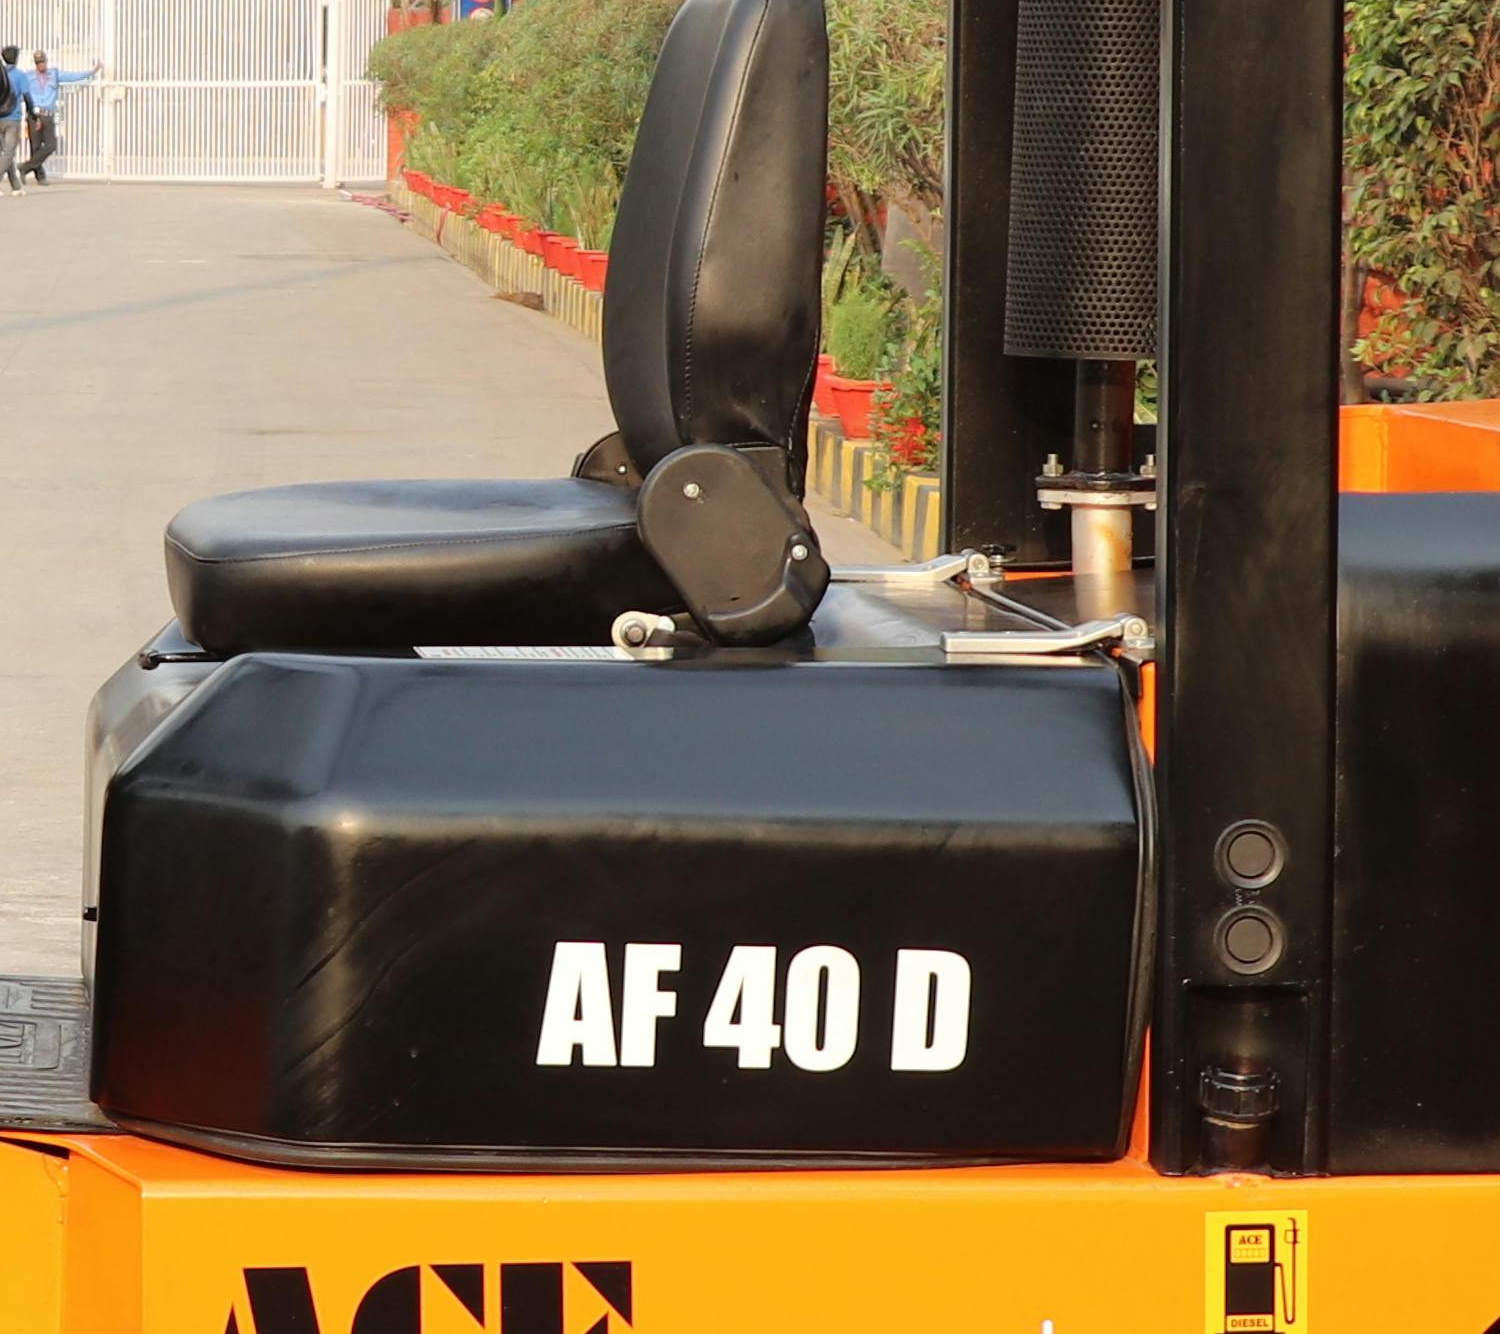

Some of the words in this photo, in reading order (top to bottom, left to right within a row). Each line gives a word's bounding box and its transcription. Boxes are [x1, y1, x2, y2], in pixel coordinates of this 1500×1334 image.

[537, 942, 682, 1067] AF
[704, 946, 860, 1071] 40
[891, 949, 971, 1071] D
[1238, 1234, 1262, 1245] ACE
[1230, 1318, 1270, 1328] DIESEL
